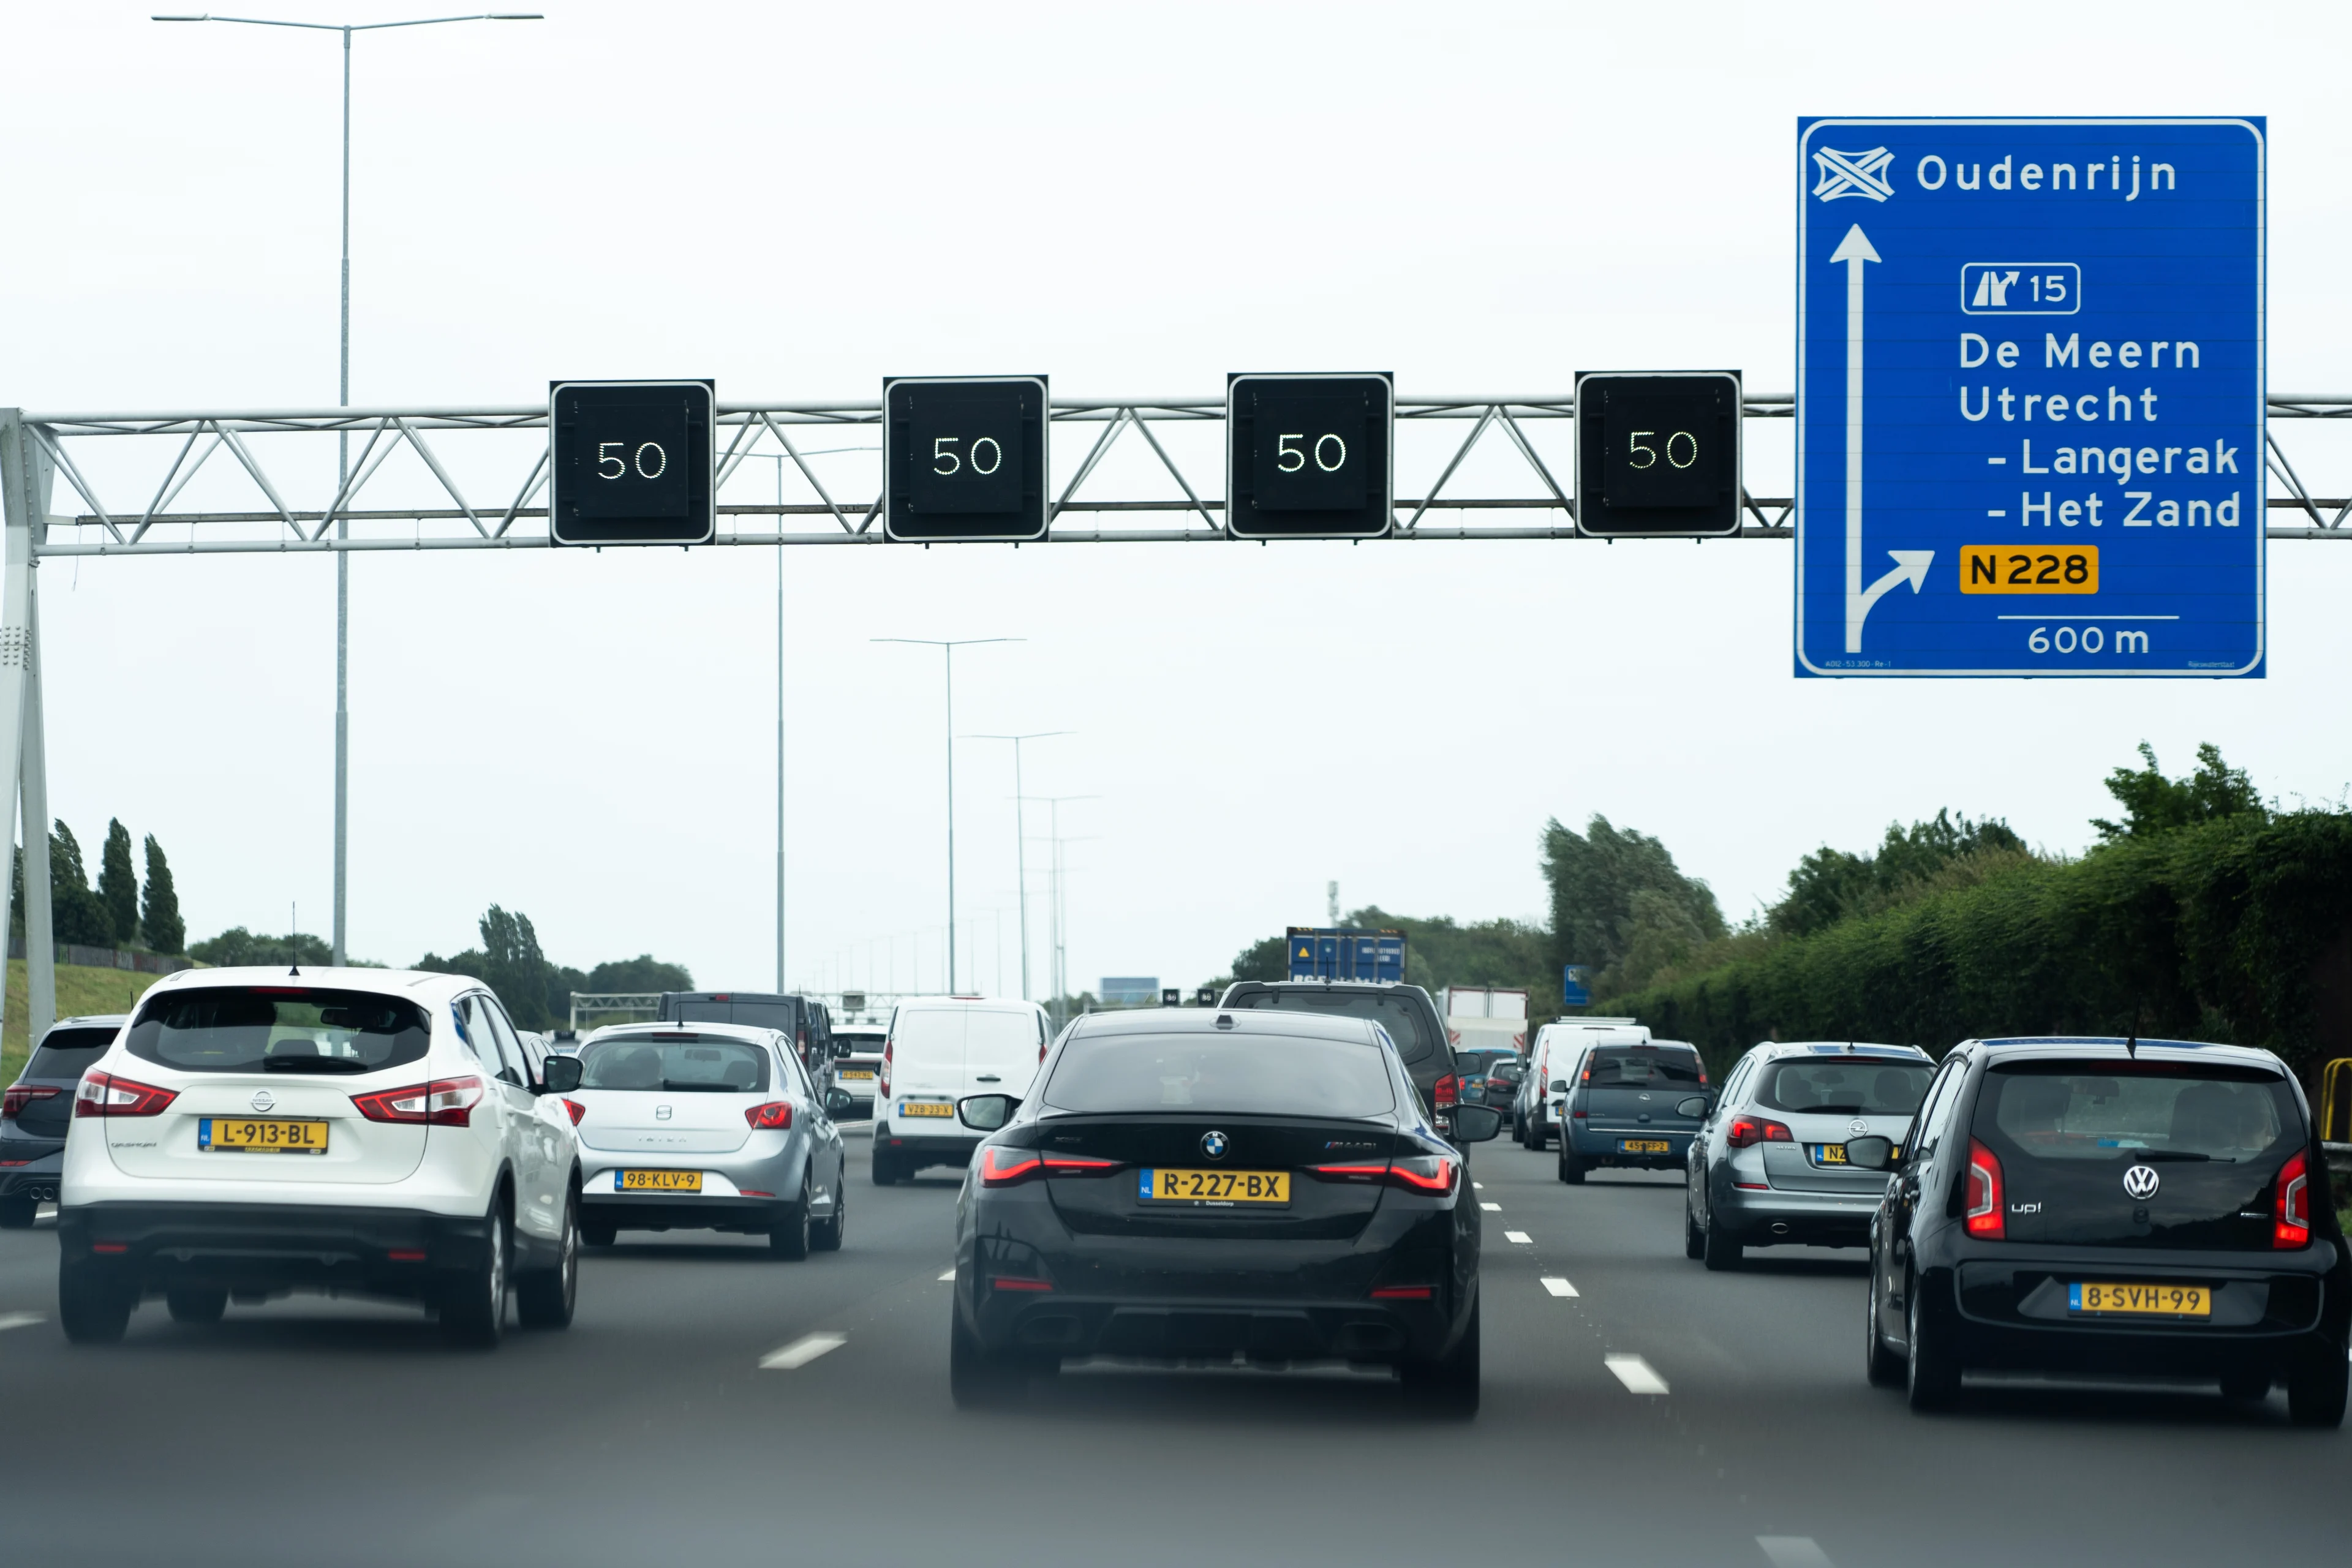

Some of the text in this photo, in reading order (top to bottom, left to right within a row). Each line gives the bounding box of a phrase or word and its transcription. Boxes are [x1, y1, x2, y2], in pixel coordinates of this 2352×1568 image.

[1917, 154, 2175, 202] Oudenrijn
[2030, 275, 2066, 302] 15
[1961, 333, 2199, 368] De Meern
[1961, 386, 2157, 421] Utrecht
[598, 442, 666, 480] 50
[933, 437, 1002, 475] 50
[1278, 433, 1346, 472] 50
[1629, 431, 1697, 469] 50
[2023, 439, 2238, 485] Langerak
[2022, 491, 2103, 527] Het
[2124, 491, 2239, 527] Zand
[2029, 627, 2148, 654] 600 m
[224, 1123, 315, 1145] L-913-BL
[1629, 1141, 1665, 1150] 45-FF-2
[627, 1173, 695, 1187] 98-KLV-9
[1164, 1173, 1280, 1198] R-227-BX
[2011, 1201, 2041, 1215] up!
[2087, 1287, 2201, 1311] 8-SVH-99
